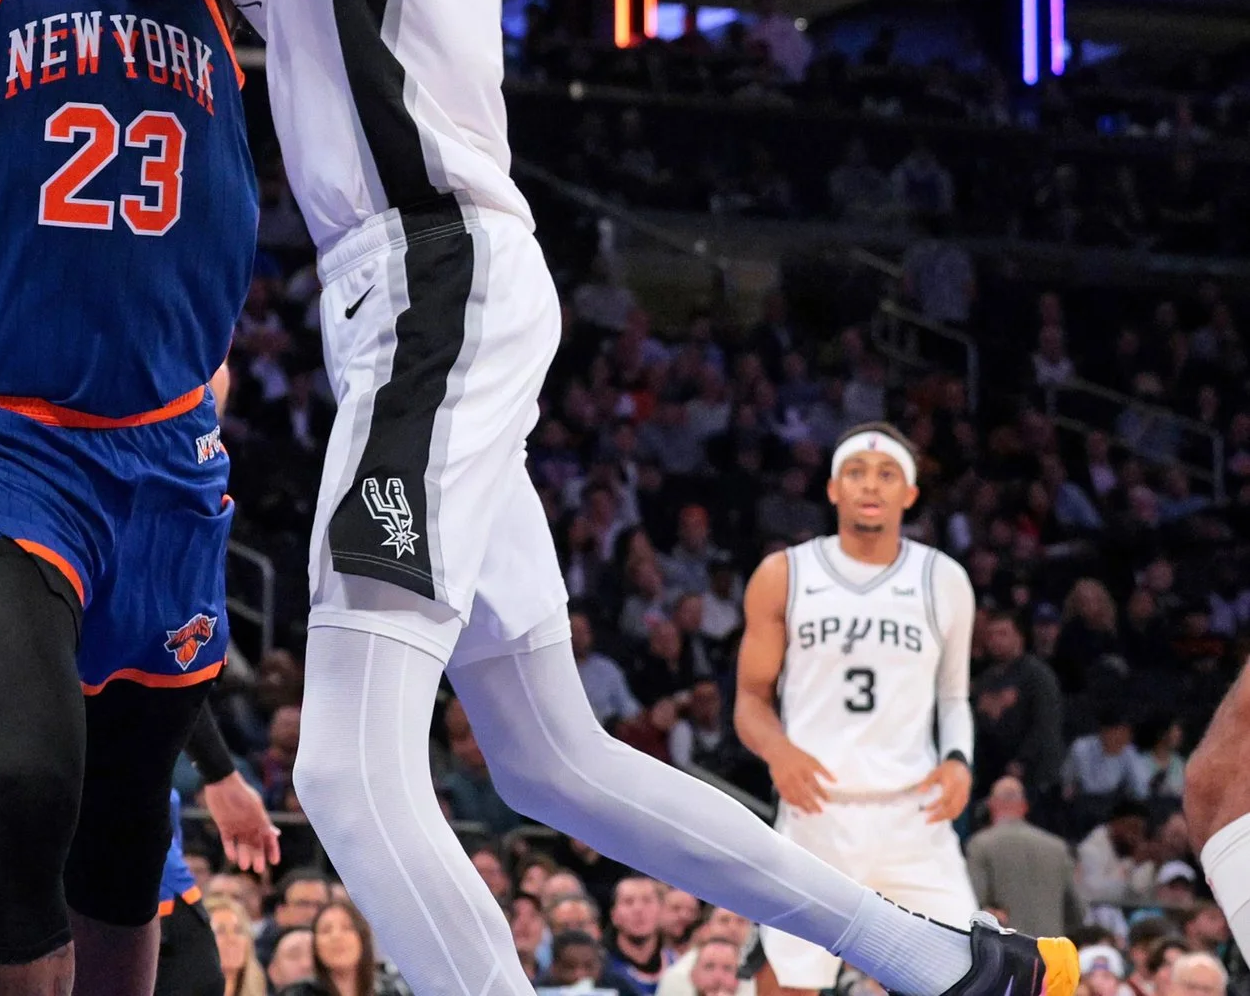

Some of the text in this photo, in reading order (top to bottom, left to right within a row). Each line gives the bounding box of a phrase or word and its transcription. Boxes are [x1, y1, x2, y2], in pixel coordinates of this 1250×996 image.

[5, 11, 214, 116] NEW YORK
[37, 101, 187, 237] 23
[798, 616, 923, 655] SPURS
[843, 667, 876, 715] 3
